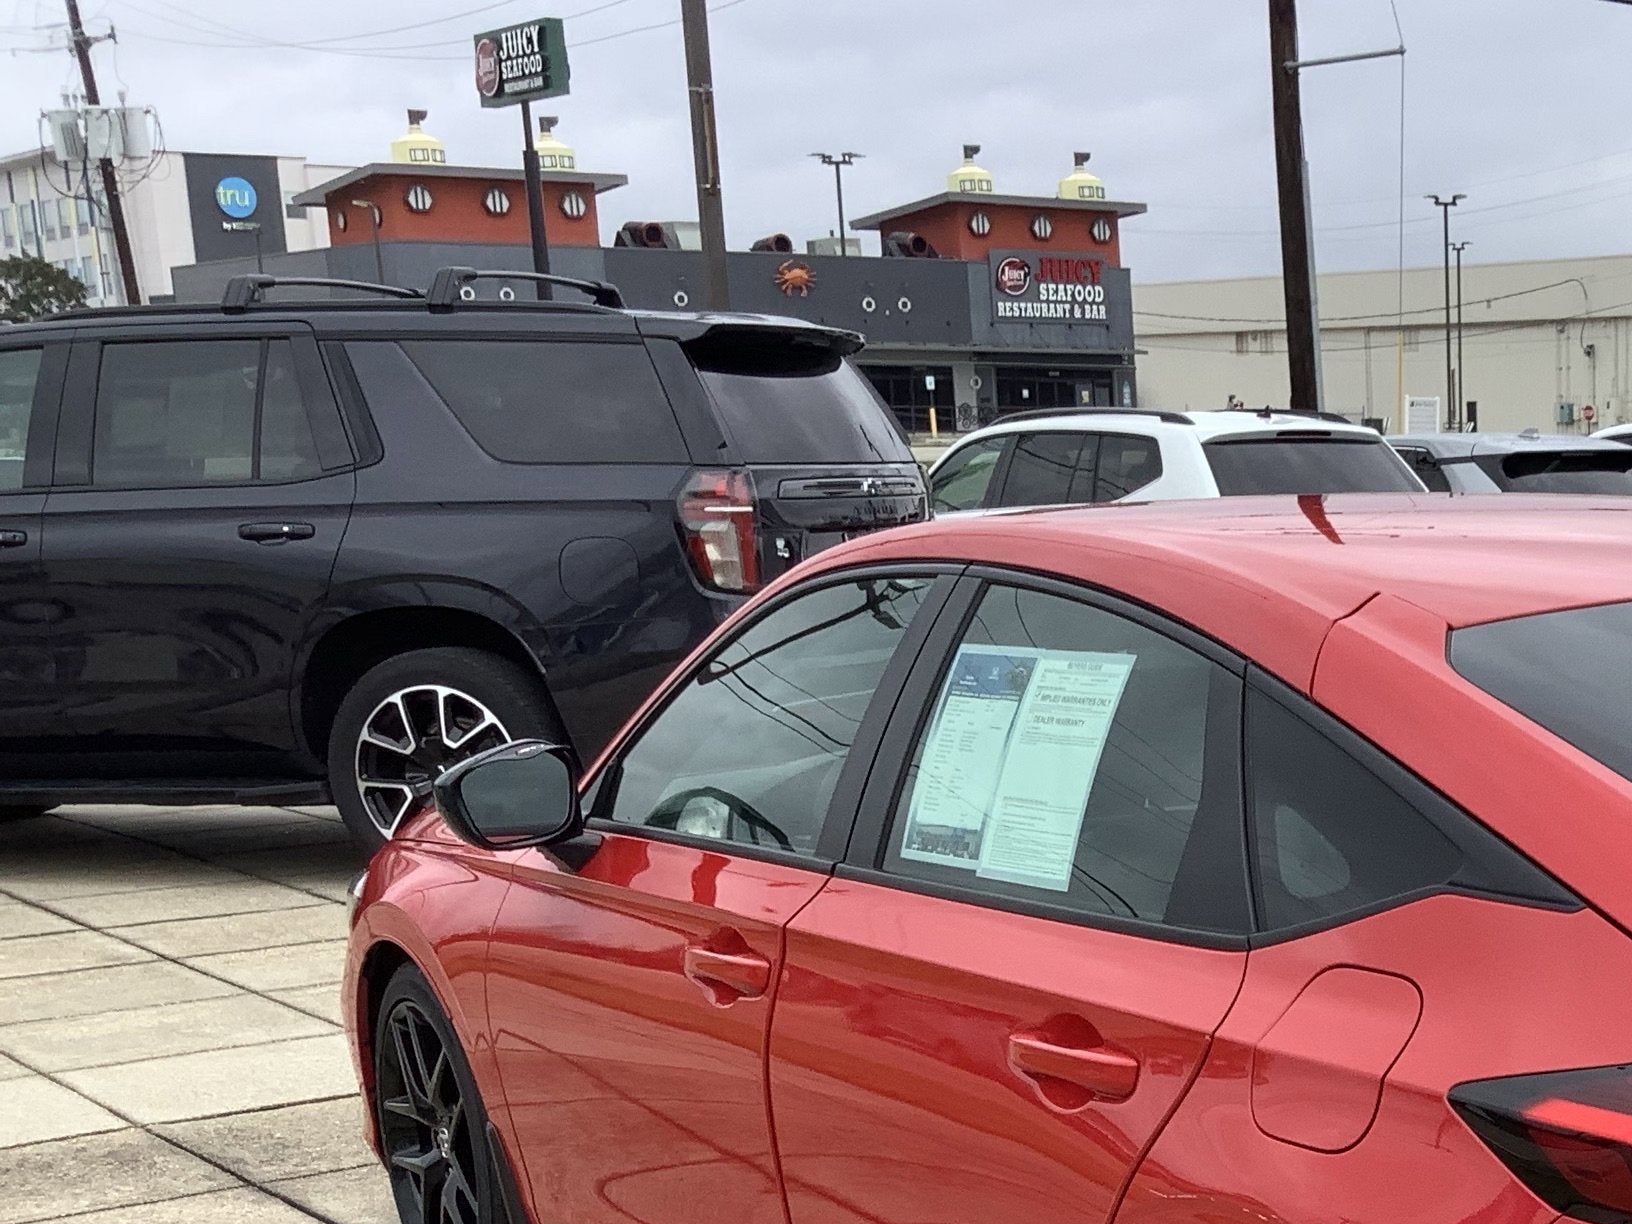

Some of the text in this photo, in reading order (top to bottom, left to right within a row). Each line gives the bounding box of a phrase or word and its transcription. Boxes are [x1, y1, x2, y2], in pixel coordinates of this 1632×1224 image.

[500, 25, 539, 60] JUICY
[501, 54, 543, 79] SEAFOOD
[216, 186, 249, 207] tru
[1035, 257, 1104, 283] JUICY
[1039, 283, 1105, 303] SEAFOOD
[997, 302, 1107, 319] RESTAURANT & BAR
